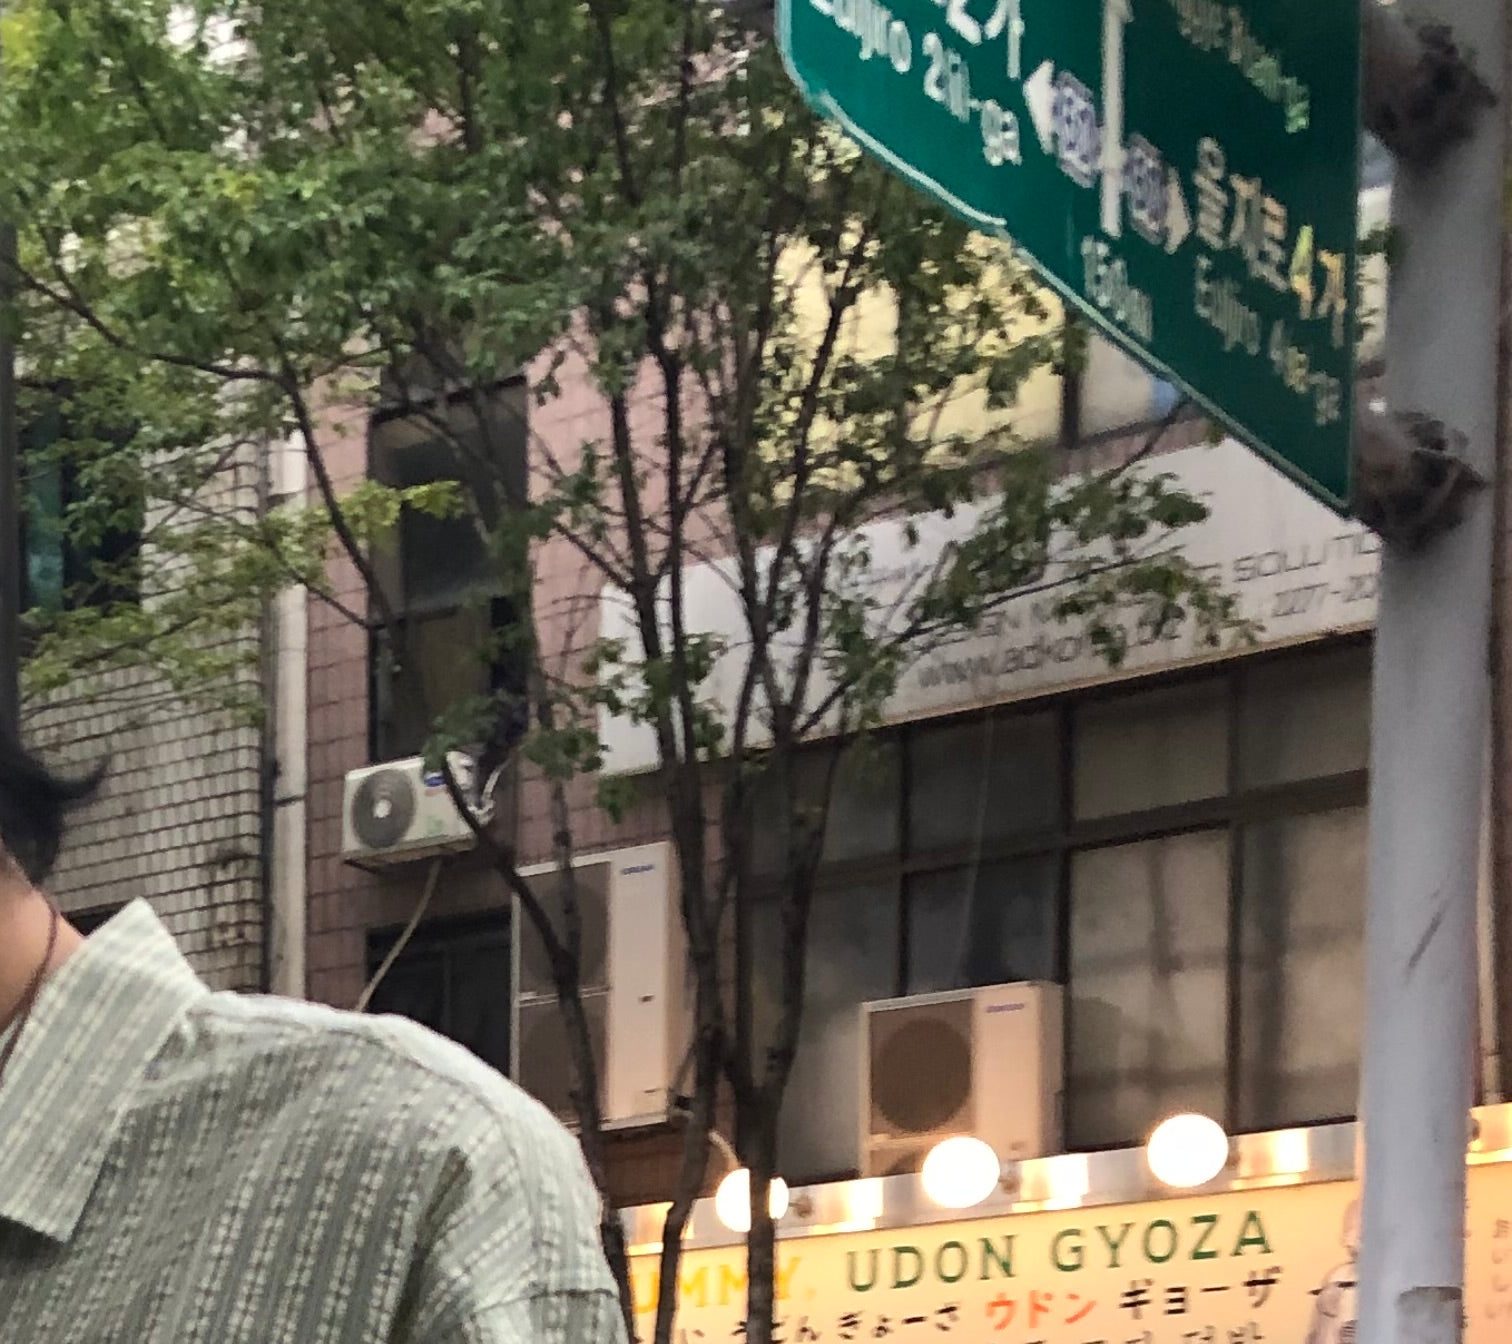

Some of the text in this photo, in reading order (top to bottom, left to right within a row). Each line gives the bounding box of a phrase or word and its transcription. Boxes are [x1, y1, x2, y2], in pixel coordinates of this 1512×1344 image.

[846, 1229, 1017, 1292] UDON
[1049, 1210, 1273, 1273] GYOZA
[987, 1292, 1096, 1330] ウドン
[1118, 1265, 1282, 1321] ギョーザ
